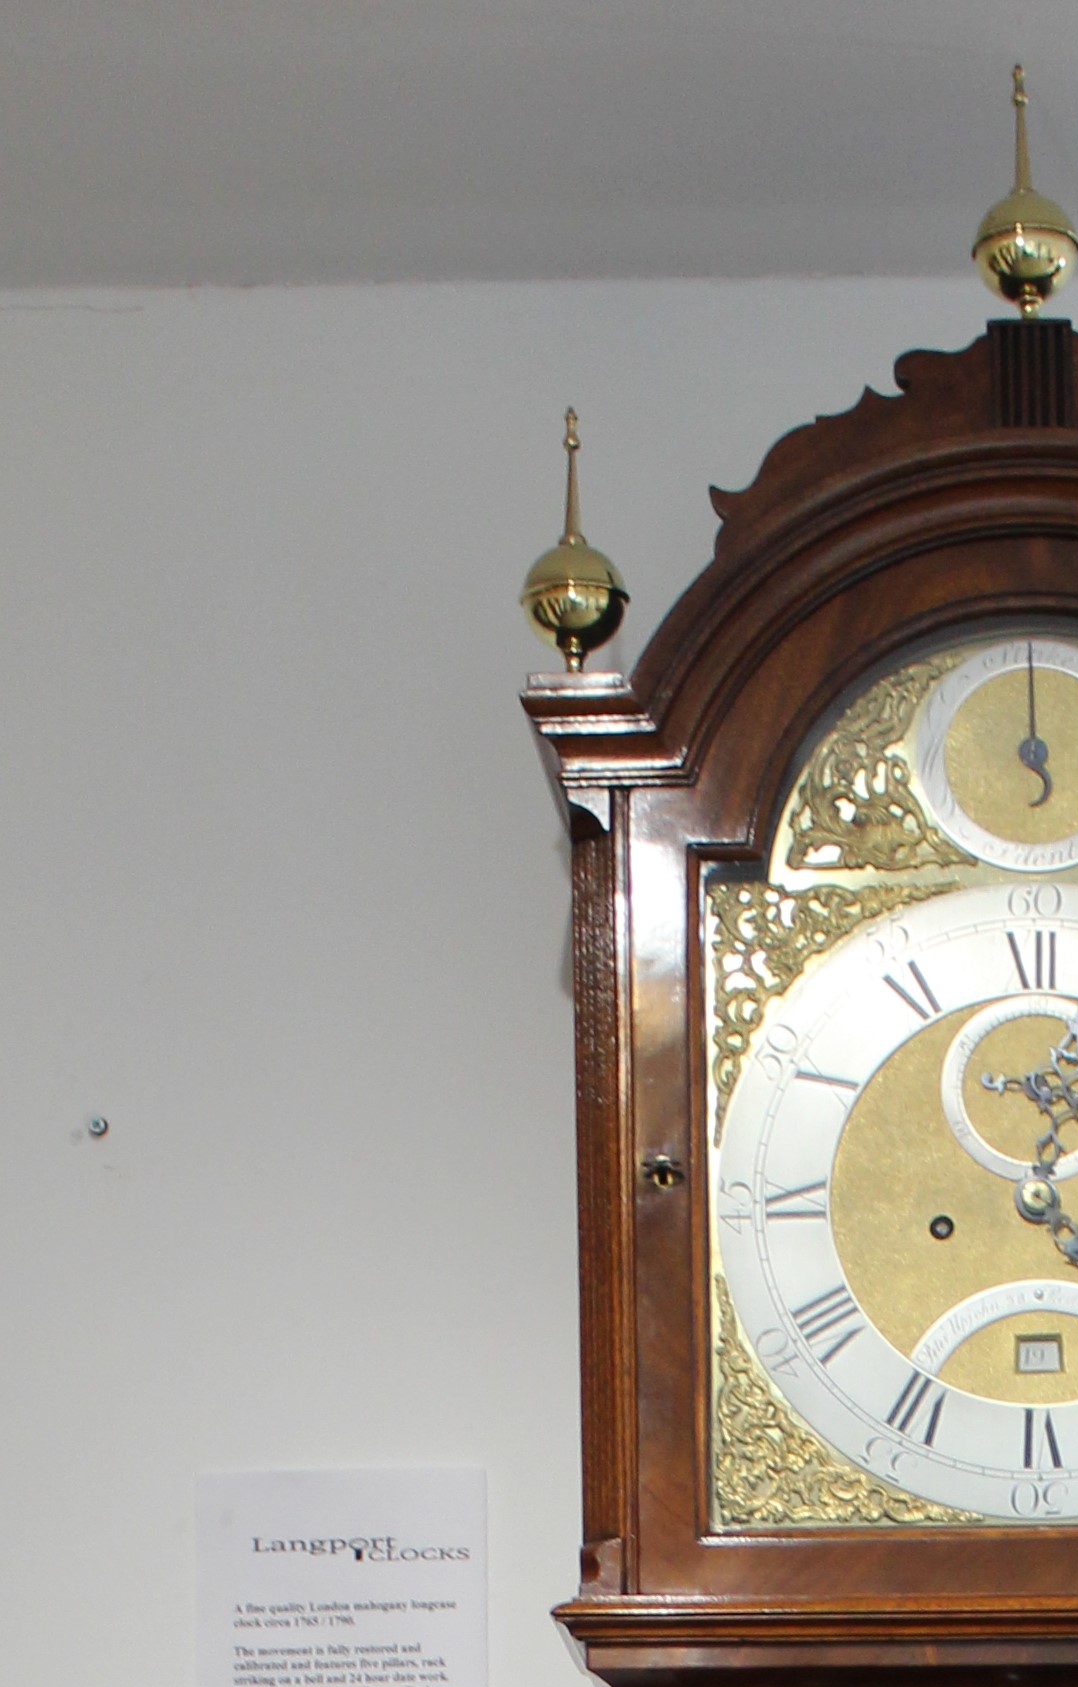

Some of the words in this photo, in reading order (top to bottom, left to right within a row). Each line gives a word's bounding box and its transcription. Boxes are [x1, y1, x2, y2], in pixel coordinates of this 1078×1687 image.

[1007, 884, 1062, 917] 60
[754, 1021, 799, 1082] 50
[720, 1177, 753, 1236] 45
[754, 1325, 802, 1378] 40
[1023, 1348, 1047, 1366] 19
[858, 1436, 922, 1484] 35
[1010, 1481, 1070, 1518] 30
[252, 1536, 397, 1556] Langport
[368, 1546, 471, 1562] CLOCKS
[245, 1602, 266, 1613] fine
[268, 1602, 305, 1615] quality
[308, 1601, 350, 1612] London
[353, 1600, 408, 1613] mahogany
[410, 1599, 457, 1612] longcase
[233, 1617, 262, 1628] clock
[264, 1618, 291, 1628] circa
[233, 1646, 256, 1657] The
[258, 1647, 313, 1657] movement
[327, 1644, 351, 1657] fully
[354, 1643, 398, 1655] restored
[400, 1642, 421, 1653] and
[233, 1660, 288, 1671] calibrated
[291, 1659, 311, 1670] and
[314, 1659, 357, 1670] features
[359, 1657, 379, 1668] five
[421, 1656, 447, 1668] rack
[233, 1675, 276, 1687] striking
[278, 1676, 292, 1684] on
[304, 1674, 325, 1684] bell
[327, 1673, 347, 1683] and
[364, 1672, 389, 1683] hour
[392, 1671, 416, 1682] date
